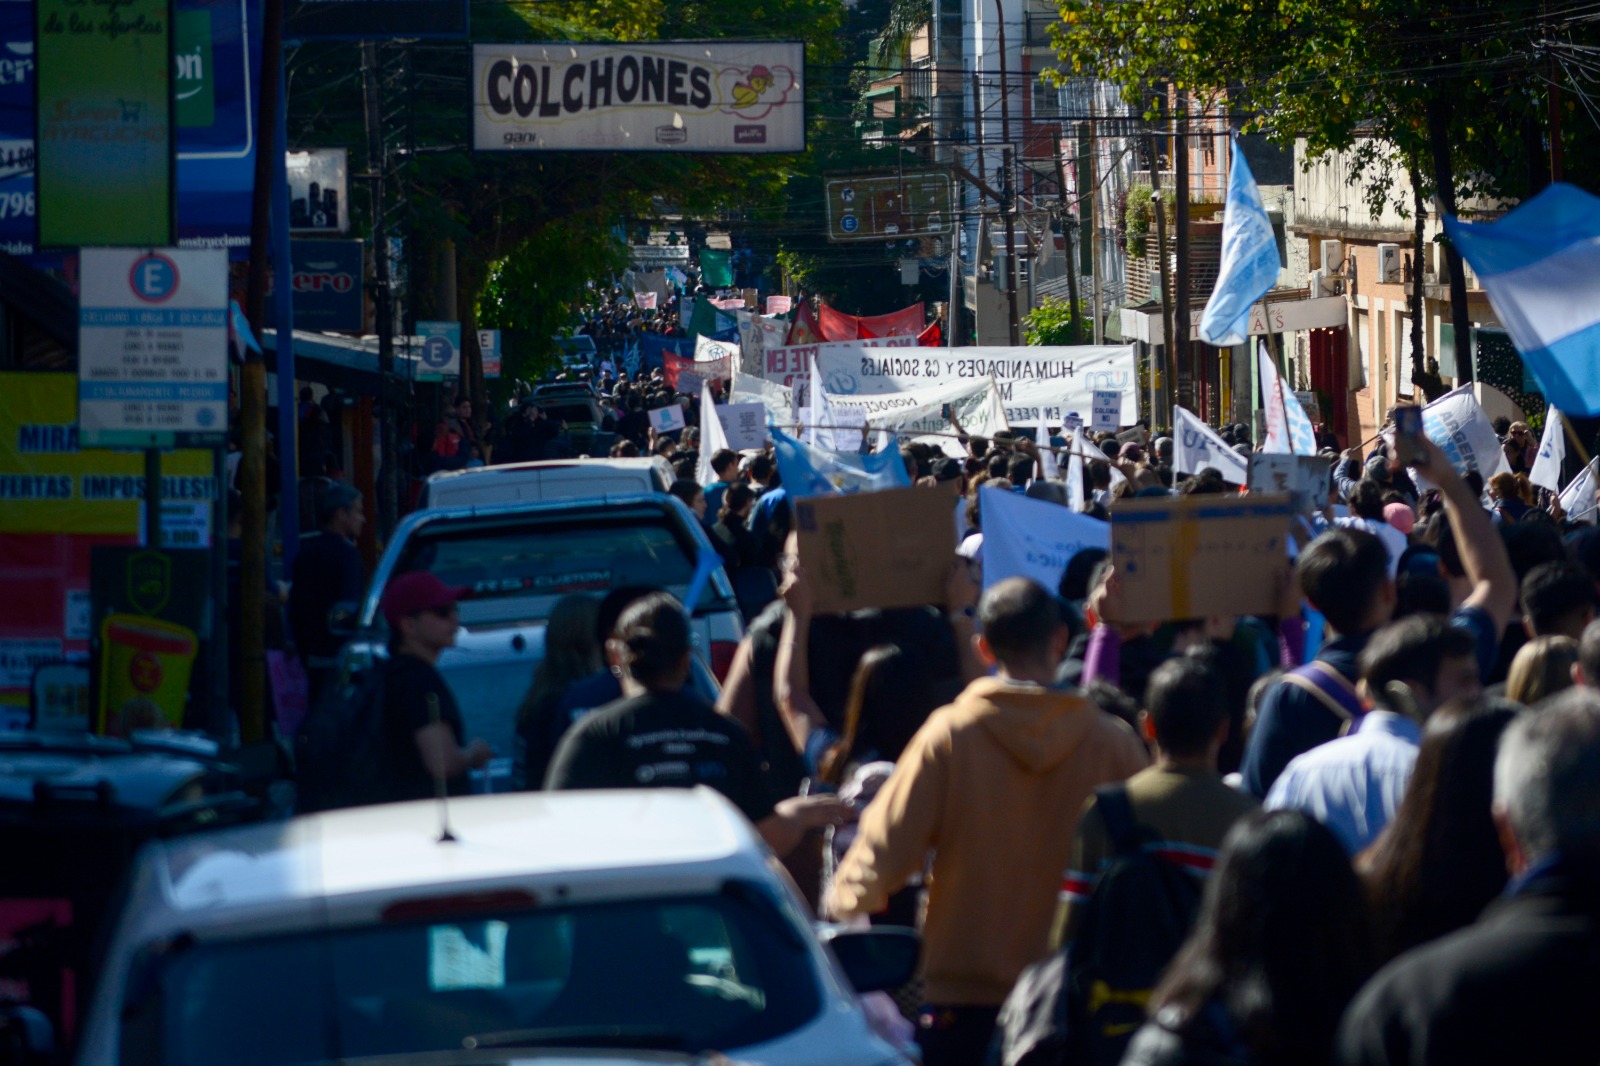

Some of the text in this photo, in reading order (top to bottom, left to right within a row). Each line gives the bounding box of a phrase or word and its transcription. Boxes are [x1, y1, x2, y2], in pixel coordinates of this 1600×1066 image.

[487, 55, 712, 118] COLCHONES
[177, 234, 251, 249] onstrucciones
[144, 263, 163, 294] E
[431, 342, 443, 361] E
[1440, 410, 1481, 474] ARGEN
